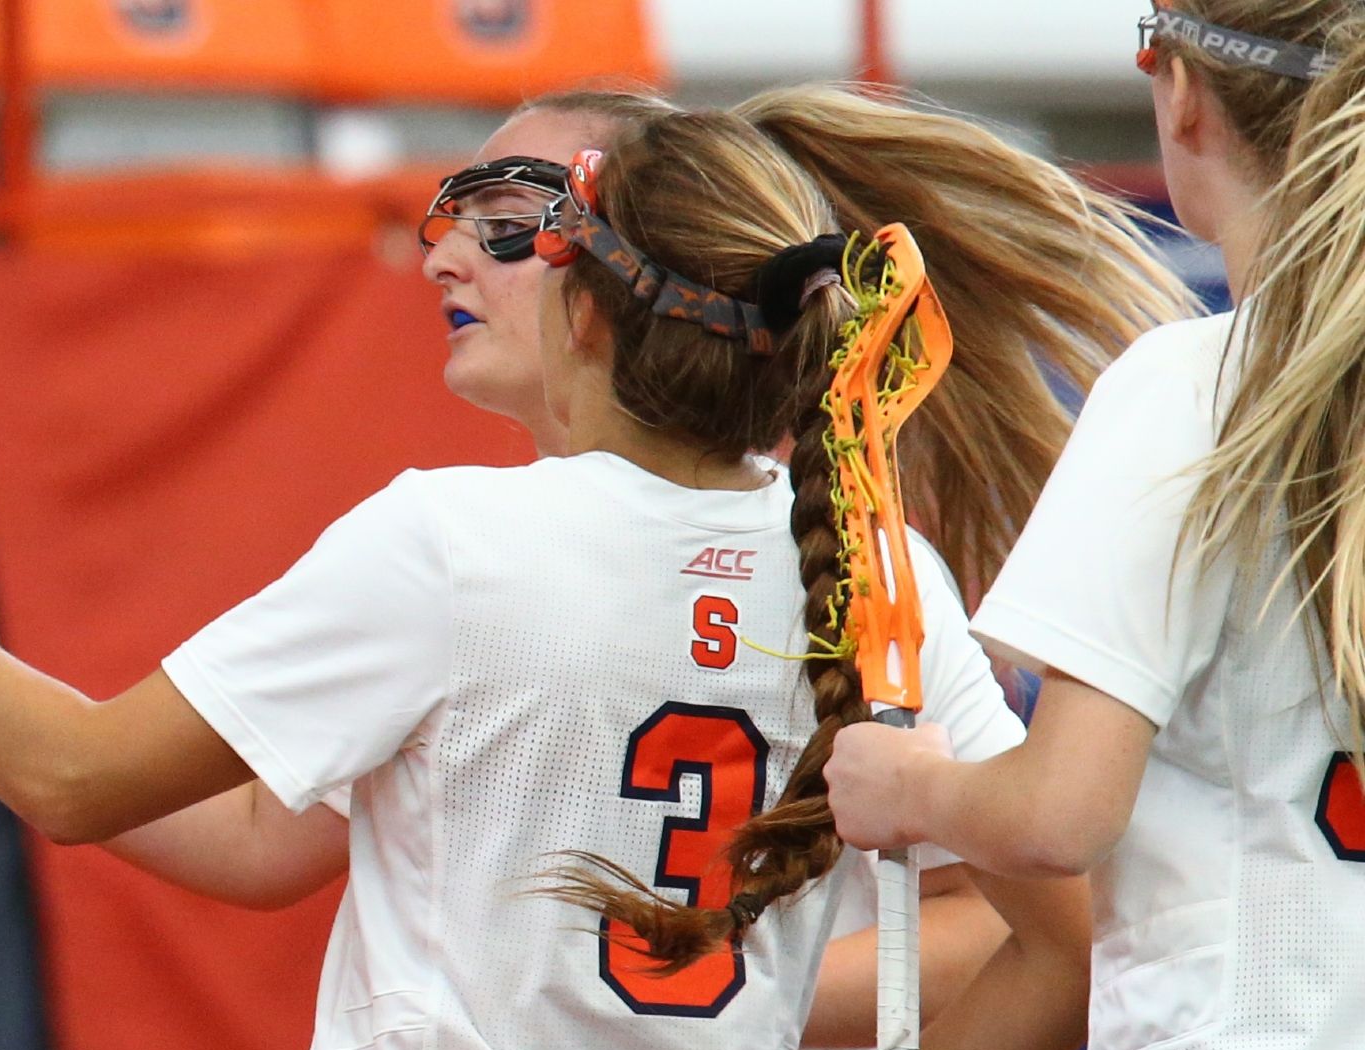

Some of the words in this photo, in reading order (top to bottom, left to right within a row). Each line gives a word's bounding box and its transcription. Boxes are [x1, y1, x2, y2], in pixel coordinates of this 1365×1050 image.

[1203, 31, 1278, 65] PRO
[682, 547, 757, 577] ACC
[691, 595, 738, 669] S
[599, 700, 770, 1018] 3
